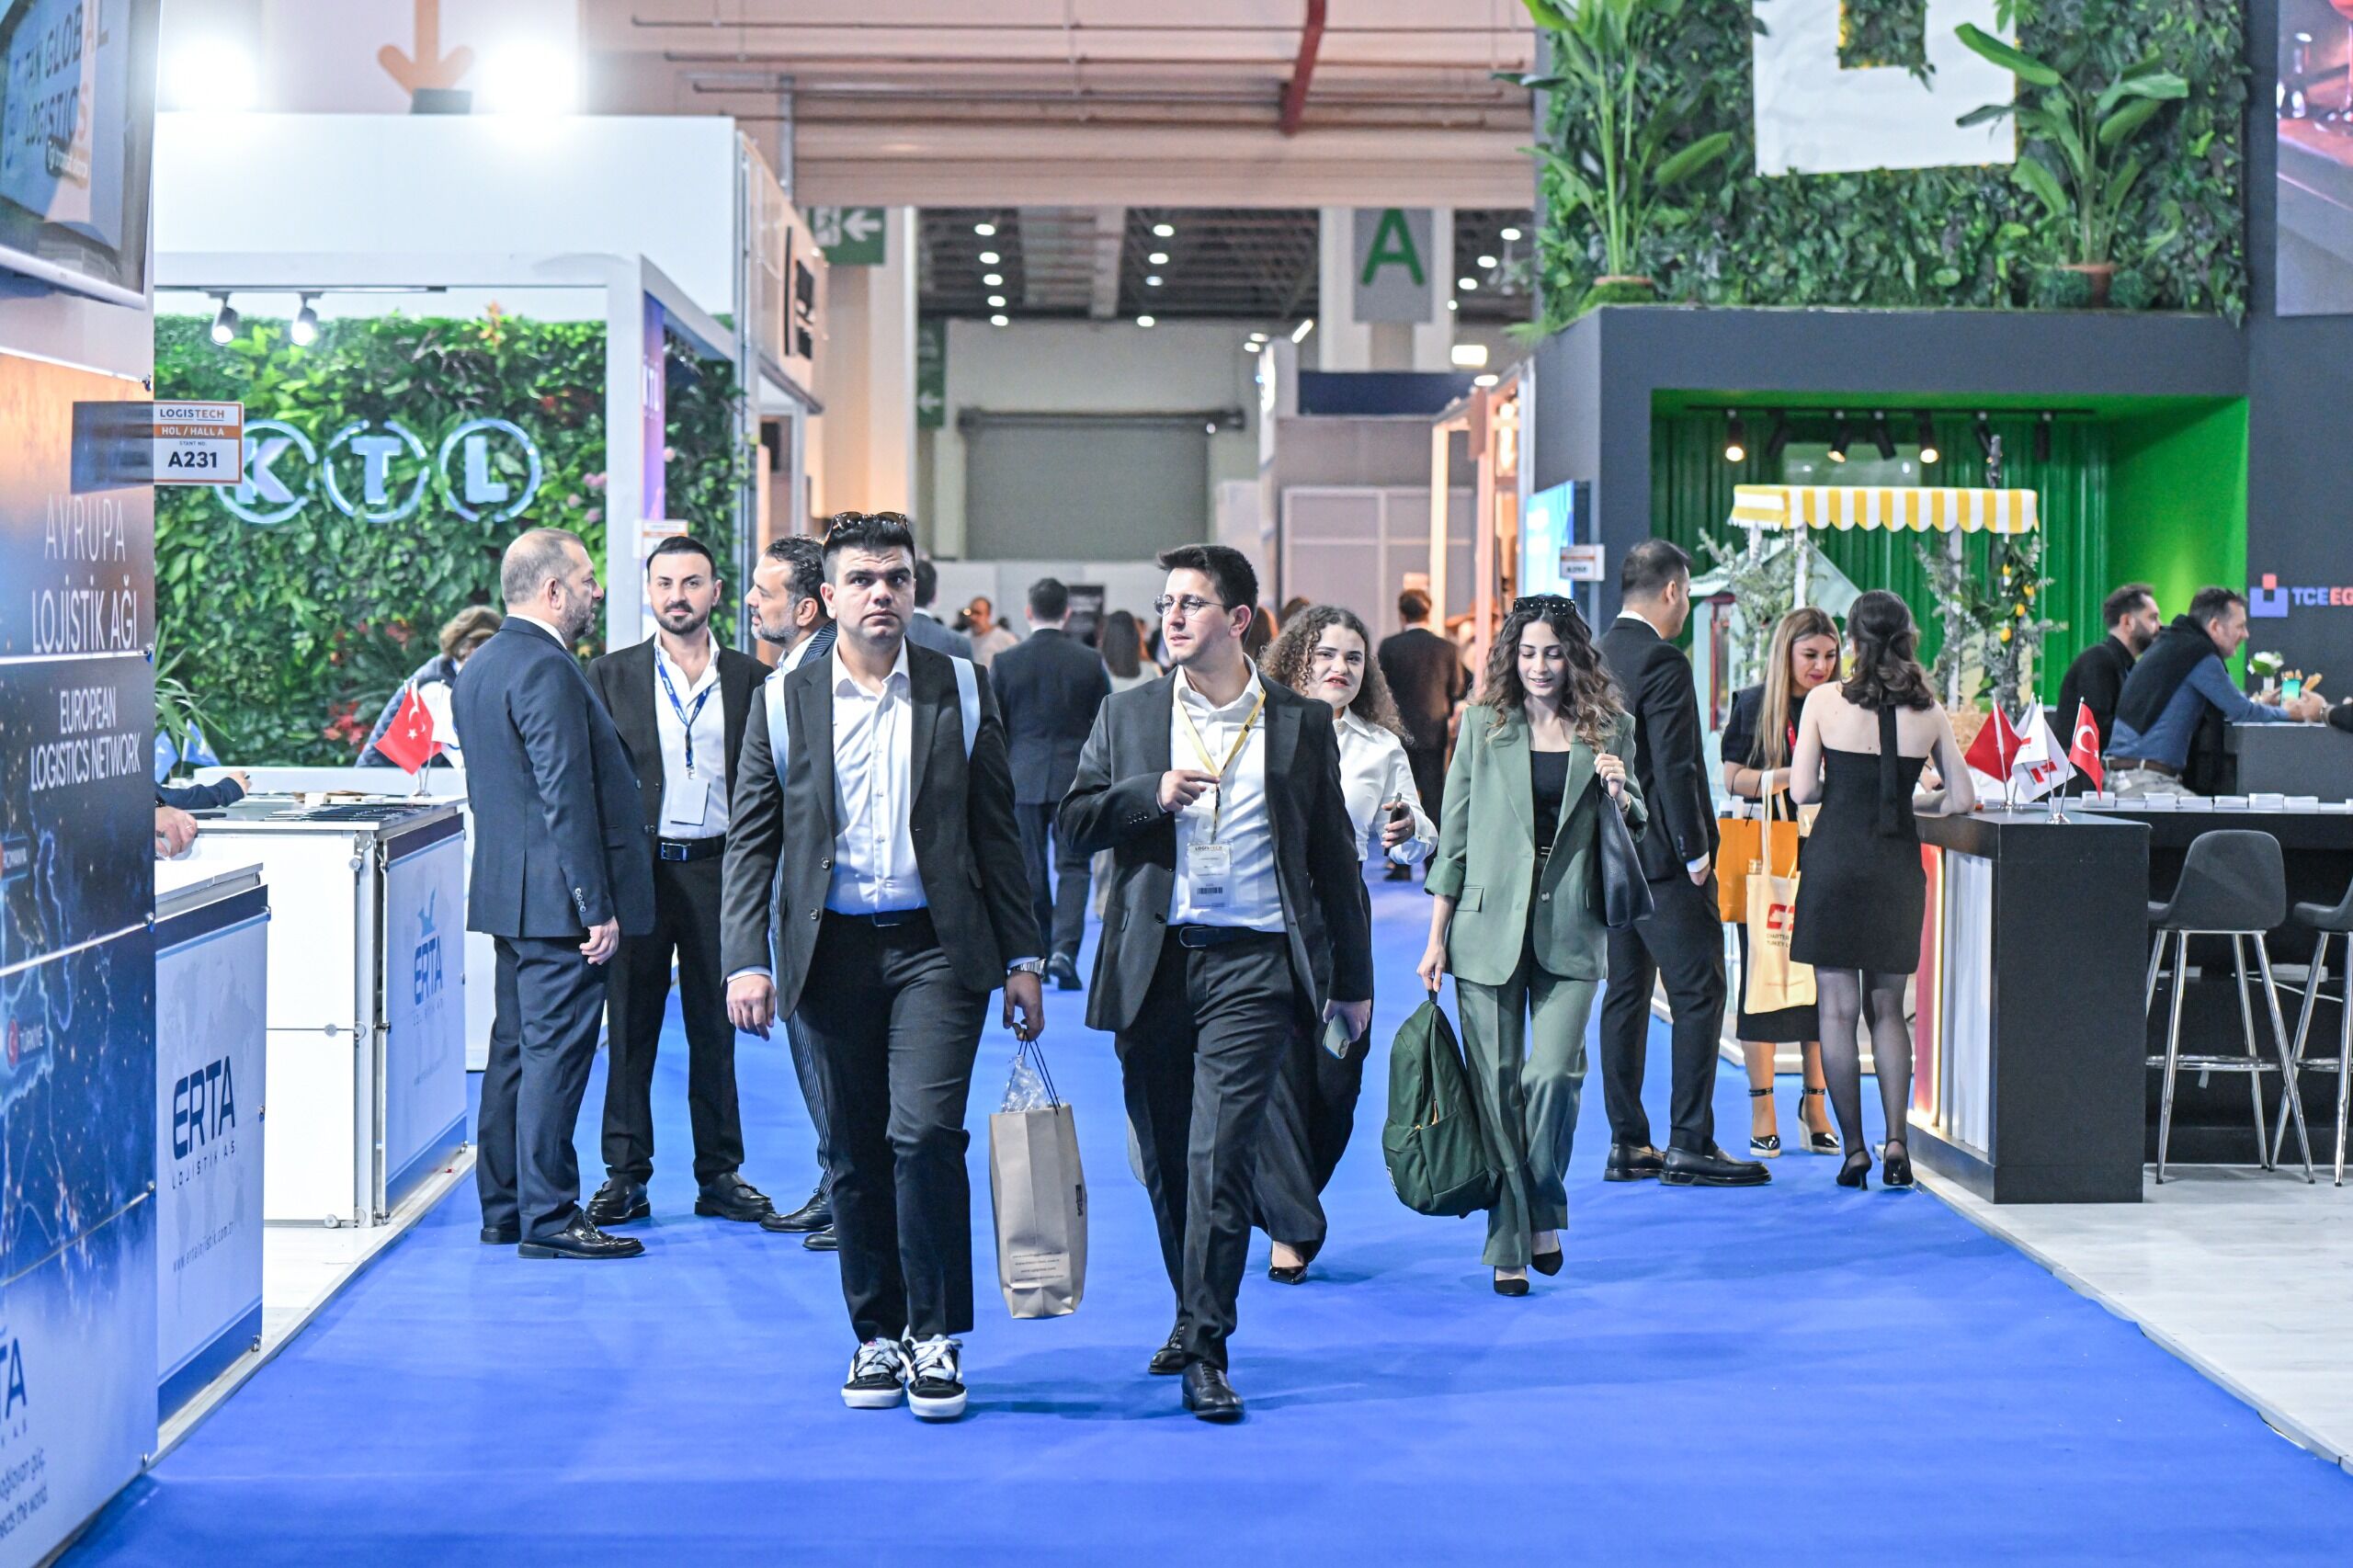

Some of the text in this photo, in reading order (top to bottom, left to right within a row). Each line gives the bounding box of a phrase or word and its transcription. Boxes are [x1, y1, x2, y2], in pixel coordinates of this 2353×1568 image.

[1360, 209, 1426, 286] A
[160, 408, 225, 419] LOGISTECH
[162, 426, 181, 436] HOL
[190, 426, 215, 437] HALL
[217, 428, 224, 437] A
[167, 450, 218, 469] A231
[235, 435, 508, 505] K T L
[45, 492, 126, 562] AVRUPA
[32, 574, 137, 654] LOJİSTİK AĞI
[60, 686, 117, 734] EUROPEAN
[30, 732, 141, 791] LOGISTICS NETWORK
[414, 935, 443, 1006] ERTA
[173, 1055, 236, 1161] ERTA
